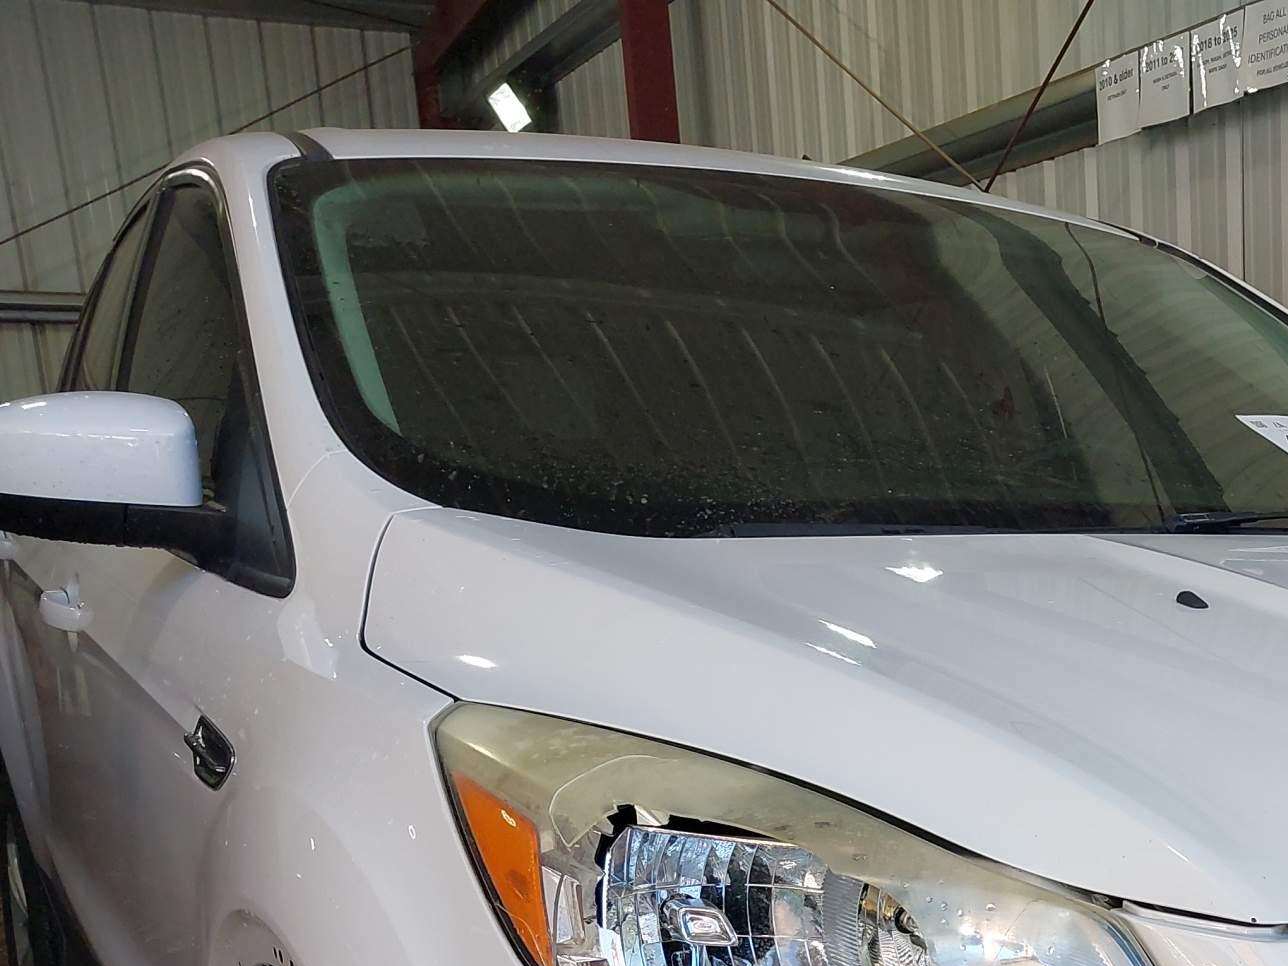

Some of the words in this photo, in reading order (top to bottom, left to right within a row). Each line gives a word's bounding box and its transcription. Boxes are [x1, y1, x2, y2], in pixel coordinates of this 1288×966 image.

[1262, 10, 1275, 25] BAG
[1275, 7, 1287, 19] ALL
[1214, 36, 1222, 47] to
[1144, 57, 1161, 73] 2011
[1161, 56, 1168, 66] to
[1098, 76, 1113, 92] 2010
[1119, 67, 1134, 82] older
